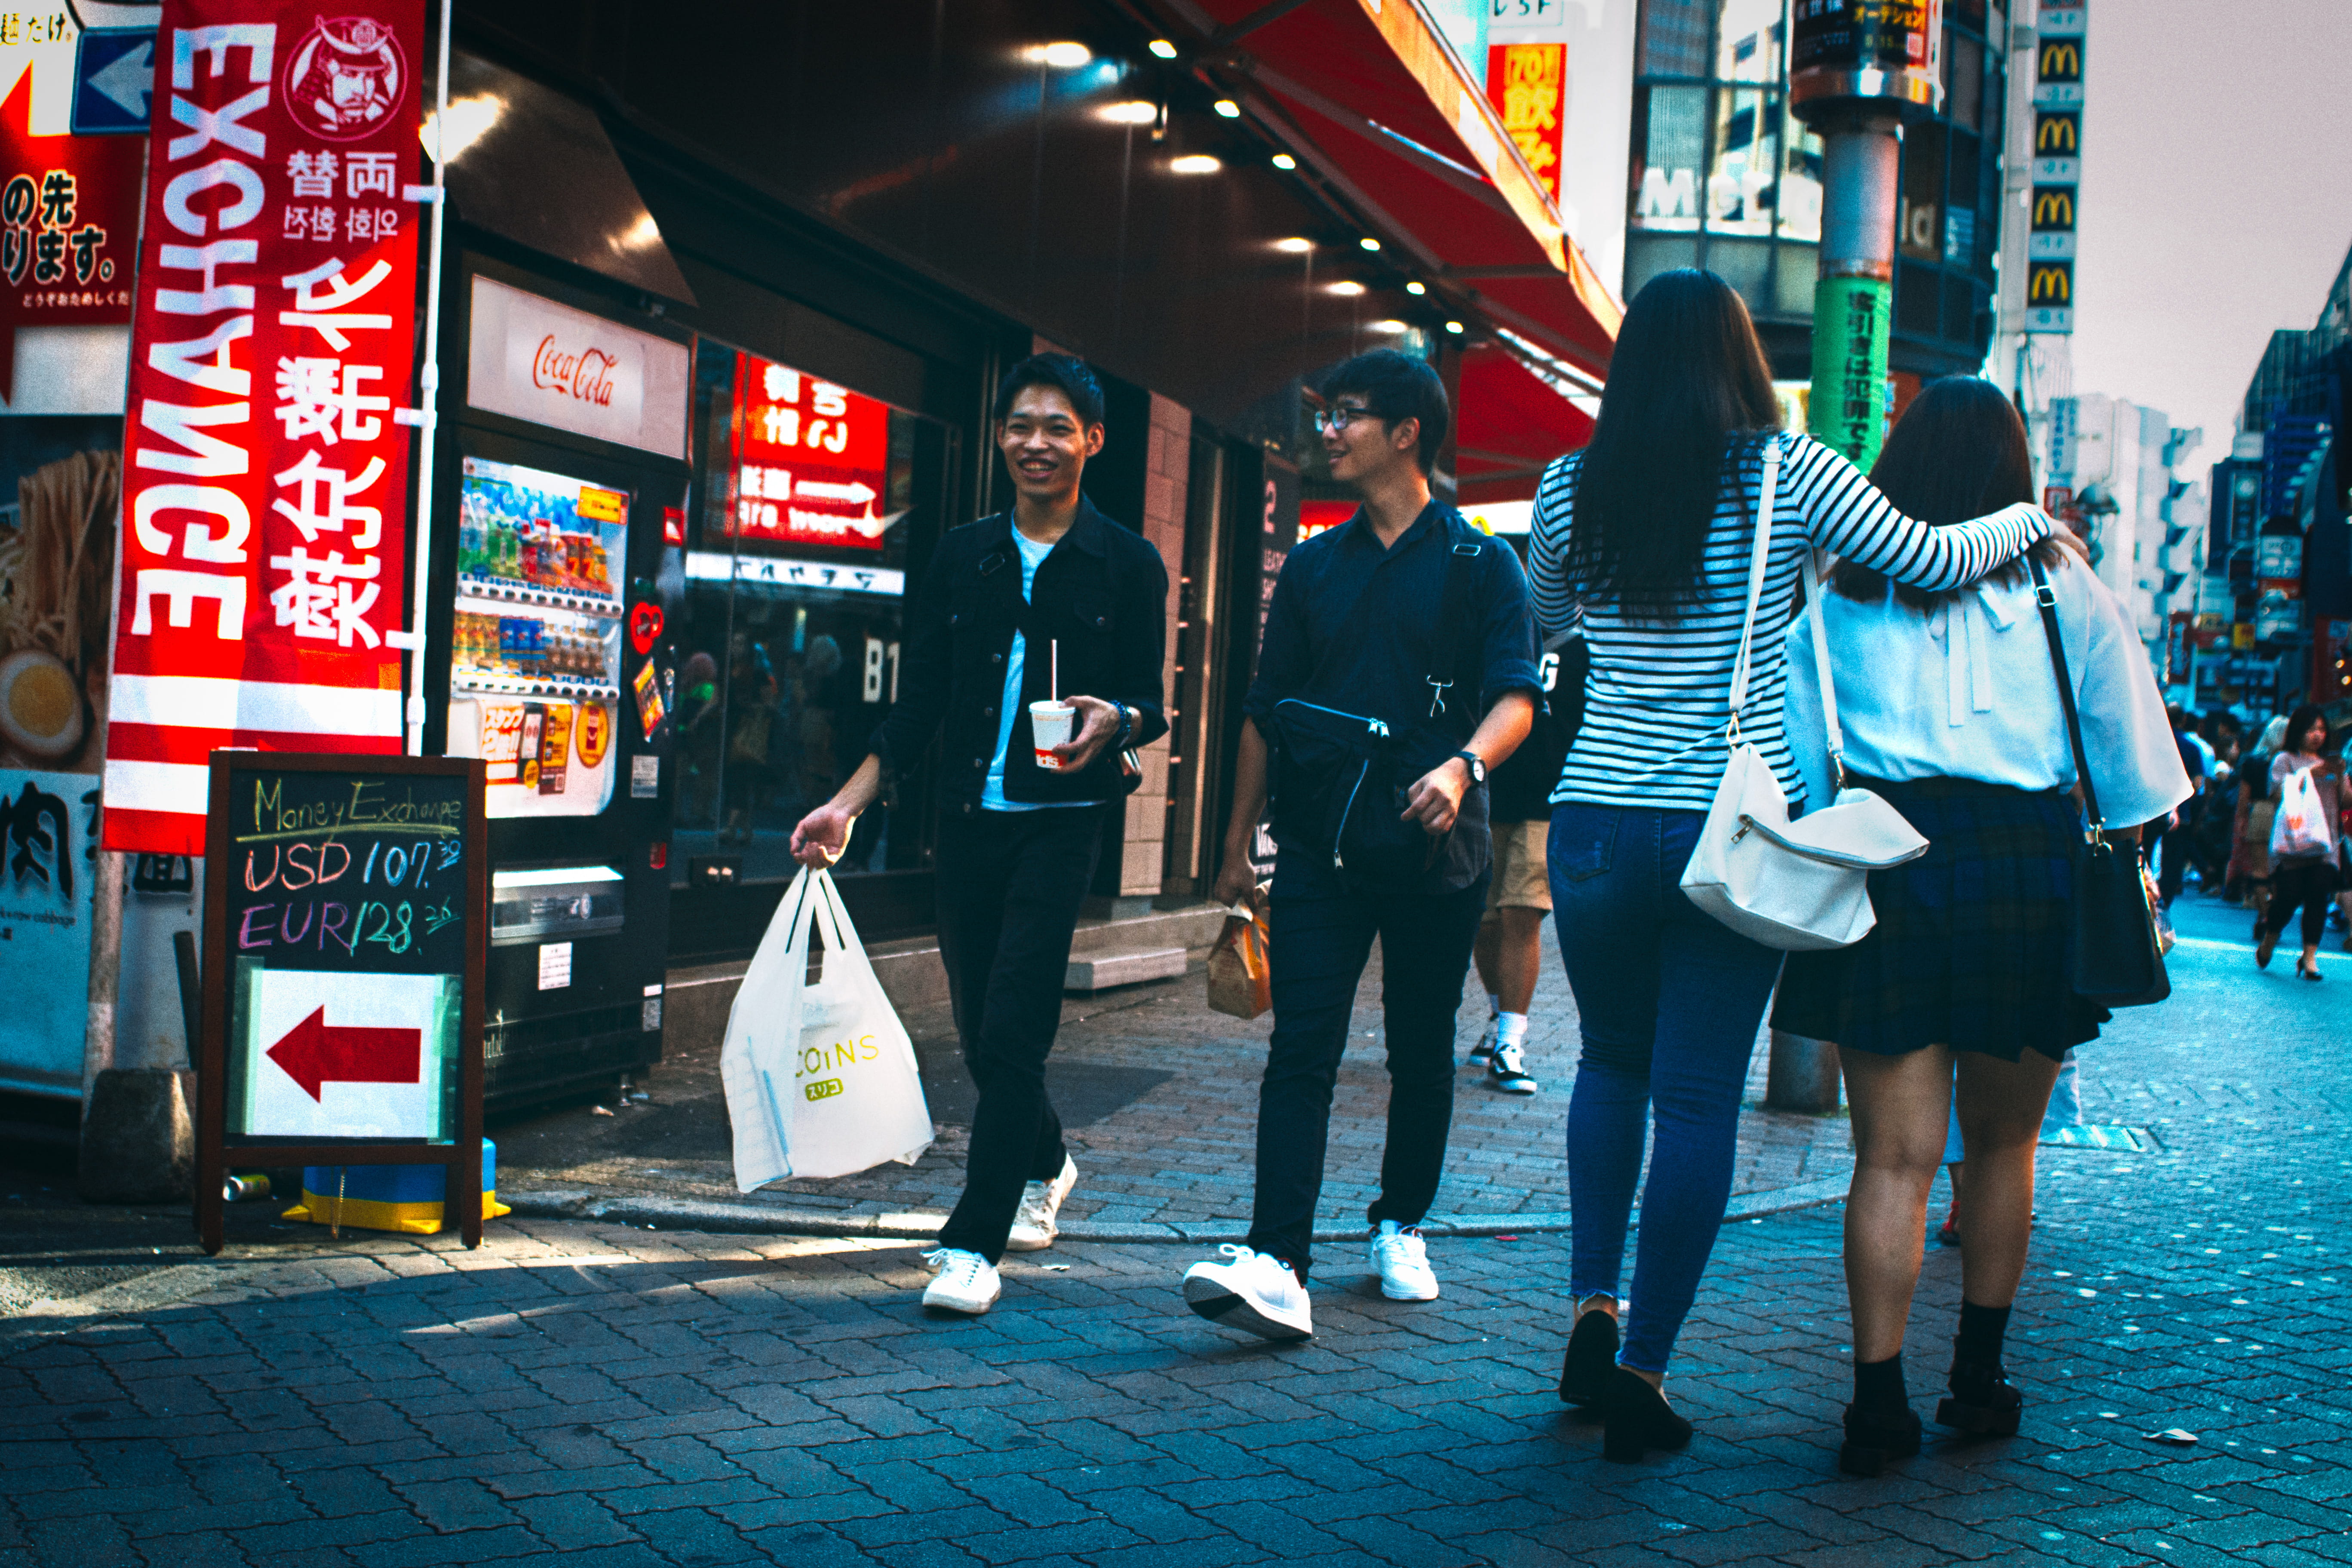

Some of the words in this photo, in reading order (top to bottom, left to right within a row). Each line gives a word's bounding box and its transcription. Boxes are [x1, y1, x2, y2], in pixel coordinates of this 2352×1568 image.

[533, 334, 619, 407] Coca-Cola
[863, 638, 900, 705] B1
[255, 778, 345, 850] Money
[245, 843, 351, 891] USD
[239, 902, 352, 951] EUR
